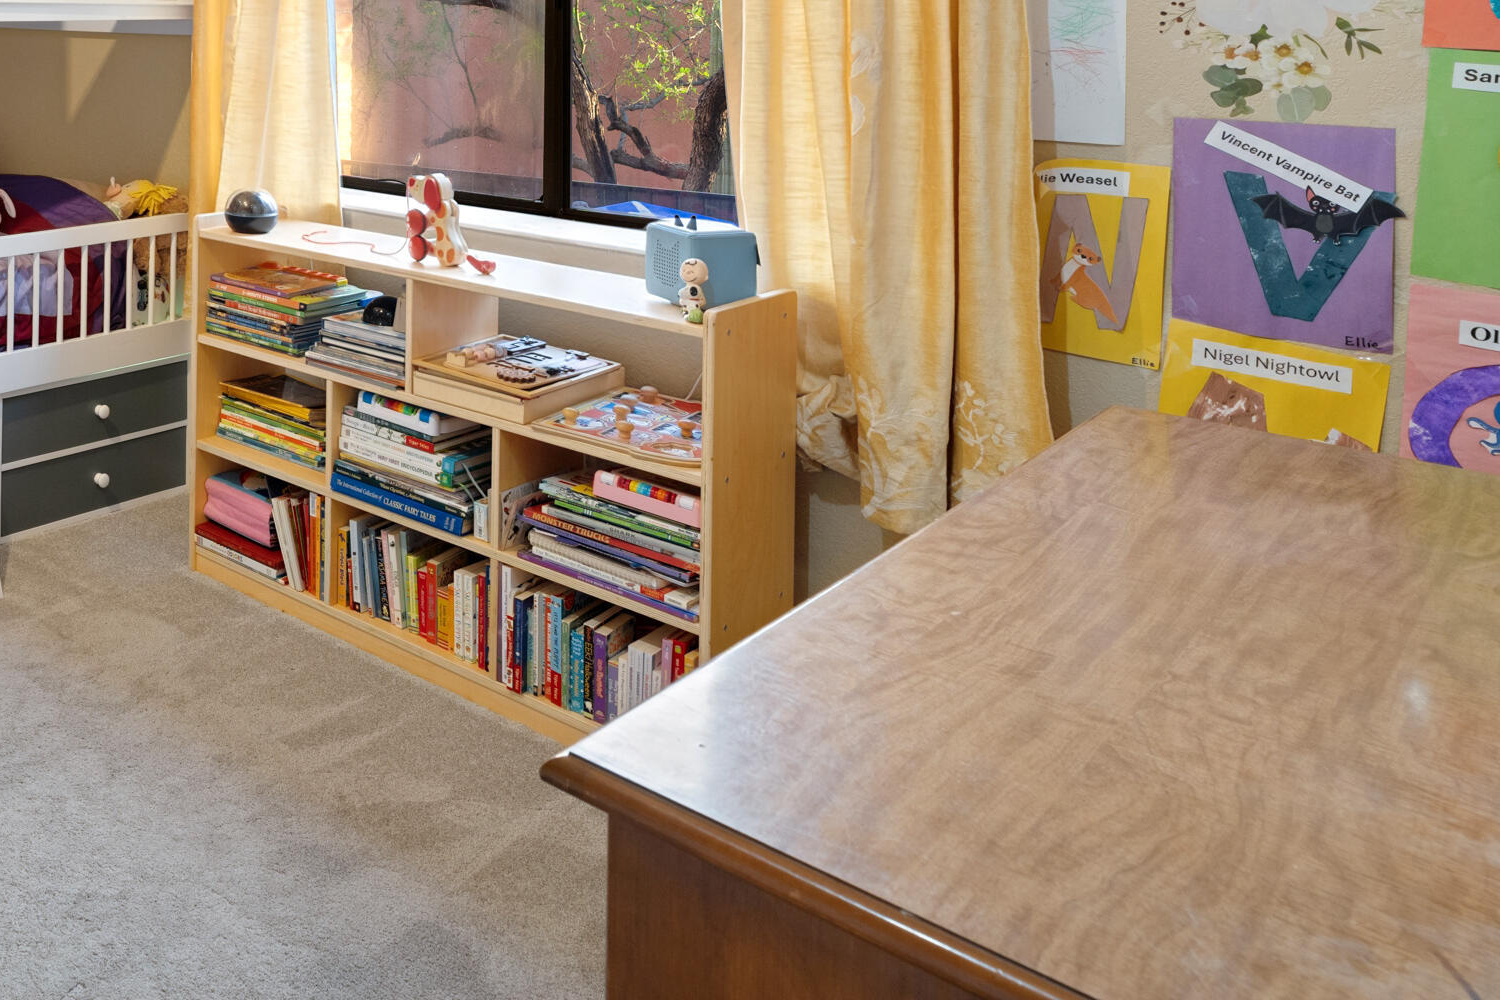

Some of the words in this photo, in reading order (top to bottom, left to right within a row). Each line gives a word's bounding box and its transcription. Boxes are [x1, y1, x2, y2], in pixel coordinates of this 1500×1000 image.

[1060, 172, 1118, 187] Weasel
[1221, 130, 1273, 162] Vincent
[1275, 156, 1333, 190] Vampire
[1334, 184, 1361, 203] Bat
[1344, 335, 1380, 350] Ellie
[1131, 357, 1155, 368] Ellie
[1203, 347, 1251, 367] Nigel
[1255, 356, 1341, 383] Nightowl
[383, 497, 404, 511] CLASSIC
[404, 504, 420, 517] FAIRY
[419, 511, 436, 523] TALES
[532, 512, 574, 534] MONSTER
[576, 524, 610, 544] TRUCKS
